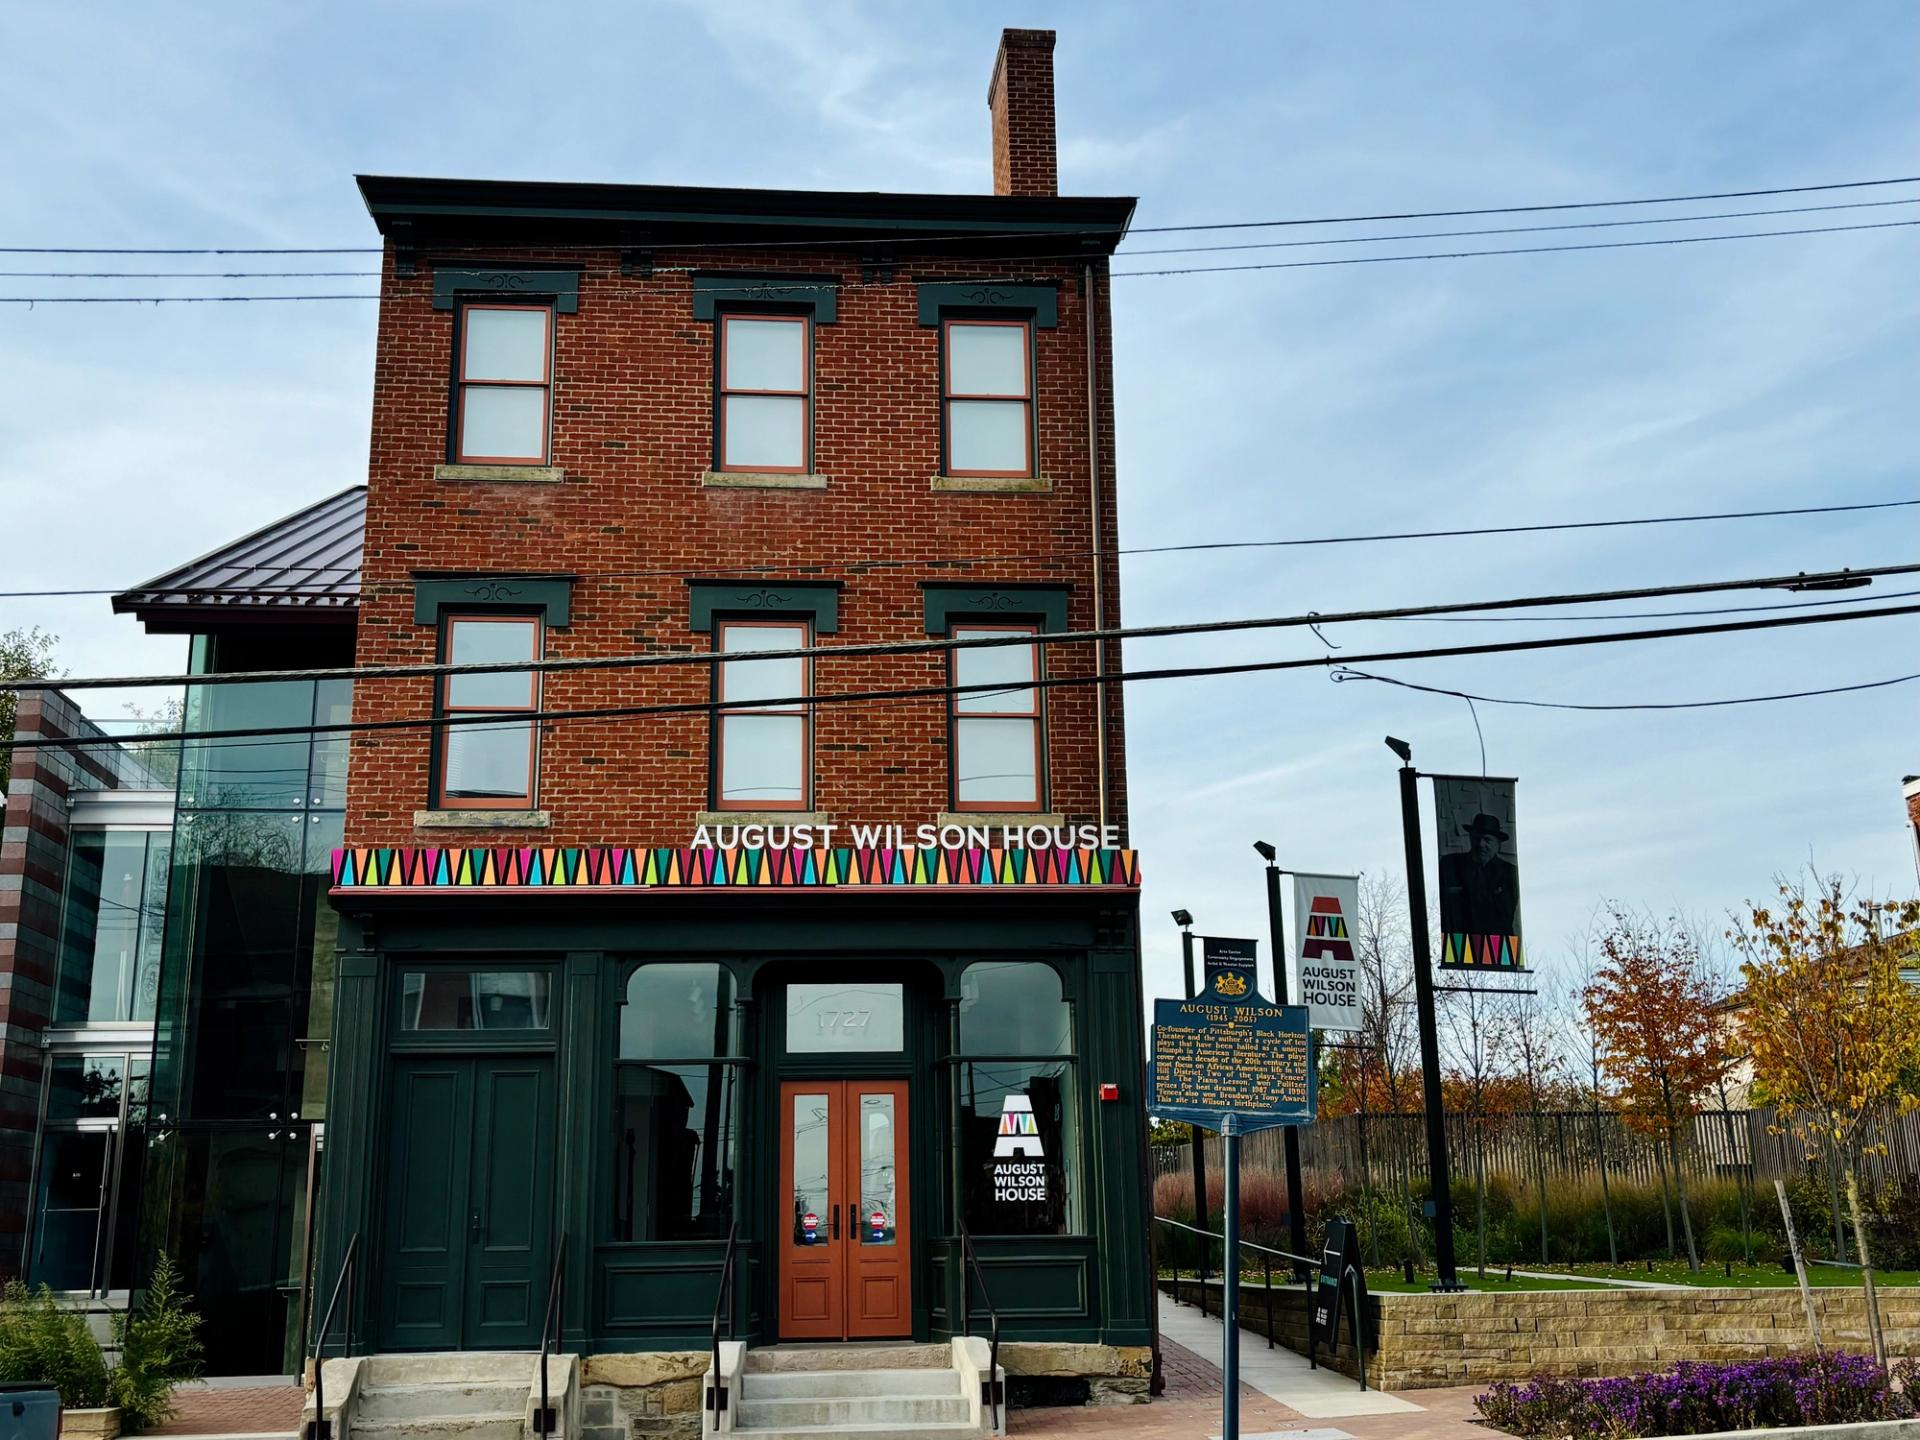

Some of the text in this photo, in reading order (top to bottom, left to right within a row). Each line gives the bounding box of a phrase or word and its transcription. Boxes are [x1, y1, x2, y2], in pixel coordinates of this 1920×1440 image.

[690, 824, 1121, 850] AUGUST WILSON HOUSE
[1302, 967, 1355, 979] AUGUST
[1303, 979, 1356, 992] WILSON
[1303, 992, 1356, 1007] HOUSE
[1180, 1004, 1283, 1017] AUGUST WILSON
[817, 1010, 872, 1028] 1727
[1210, 1028, 1252, 1037] Pittsburgh's
[1197, 1048, 1229, 1056] American
[1262, 1094, 1279, 1102] Tony
[994, 1164, 1045, 1174] AUGUST
[994, 1176, 1045, 1186] WILSON
[995, 1188, 1046, 1201] HOUSE
